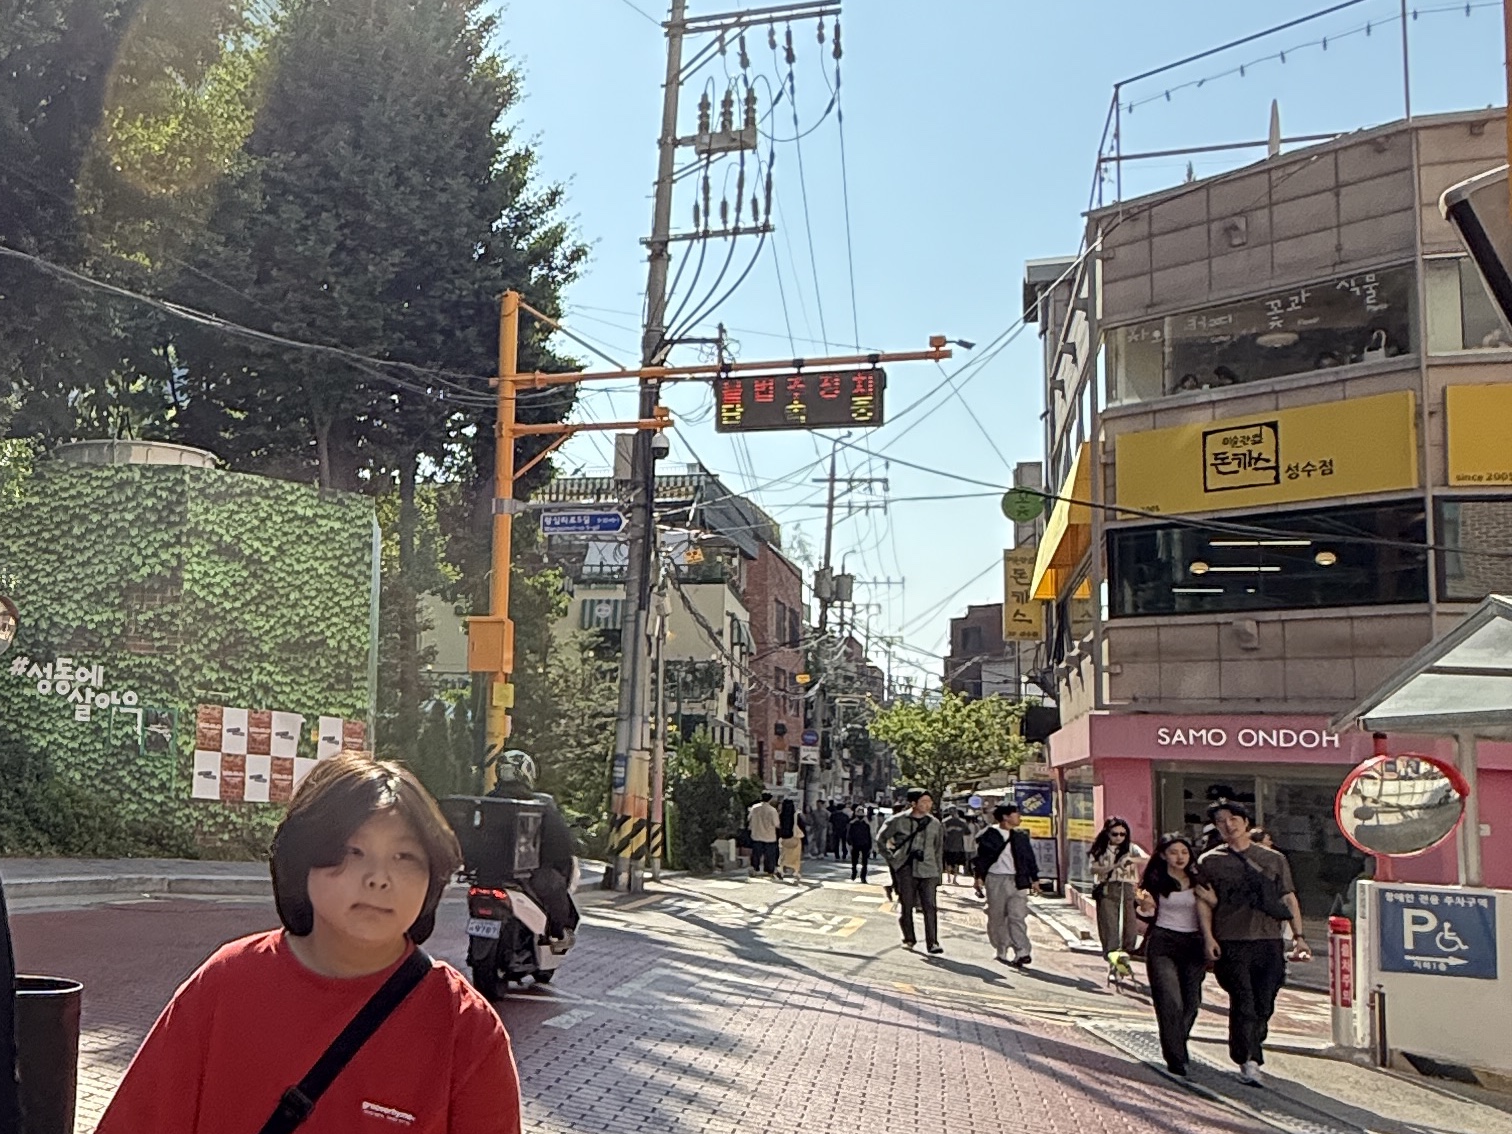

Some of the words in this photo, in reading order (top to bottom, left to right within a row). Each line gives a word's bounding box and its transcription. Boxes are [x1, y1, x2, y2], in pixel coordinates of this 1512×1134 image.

[1265, 289, 1311, 329] 꽃과
[1336, 273, 1380, 305] 식물
[1210, 449, 1276, 475] 돈까스
[1284, 458, 1334, 480] 성수점
[1456, 474, 1484, 482] since
[9, 656, 104, 695] #성동에
[1157, 727, 1227, 747] SAMO
[1238, 729, 1340, 748] ONDOH
[1385, 892, 1415, 903] 장애인
[1418, 894, 1440, 905] 전용
[1402, 907, 1437, 950] P
